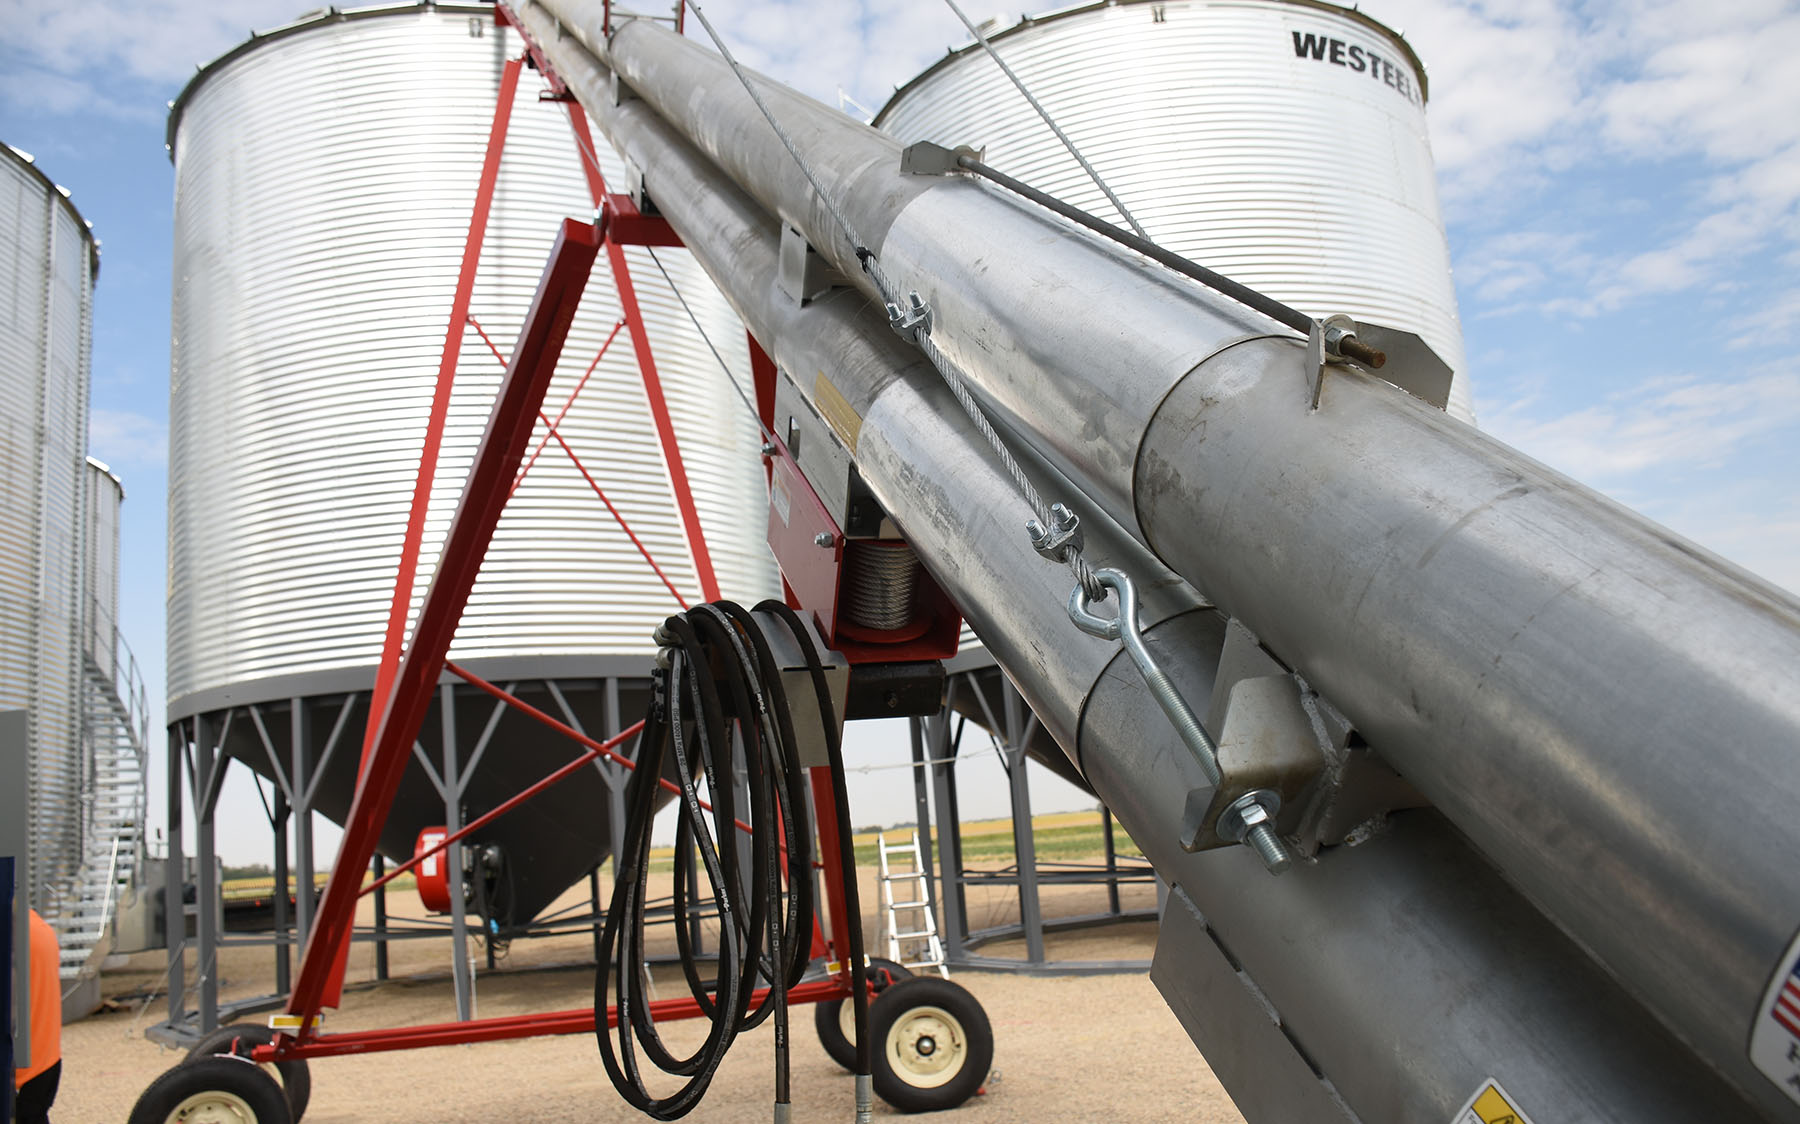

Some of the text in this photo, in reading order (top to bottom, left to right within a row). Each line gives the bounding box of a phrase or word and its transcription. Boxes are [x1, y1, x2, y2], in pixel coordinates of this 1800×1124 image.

[1292, 31, 1416, 105] WESTEEL
[672, 707, 680, 721] PSI)
[674, 722, 682, 741] (4000
[676, 741, 684, 757] MPa
[721, 888, 730, 911] Parker
